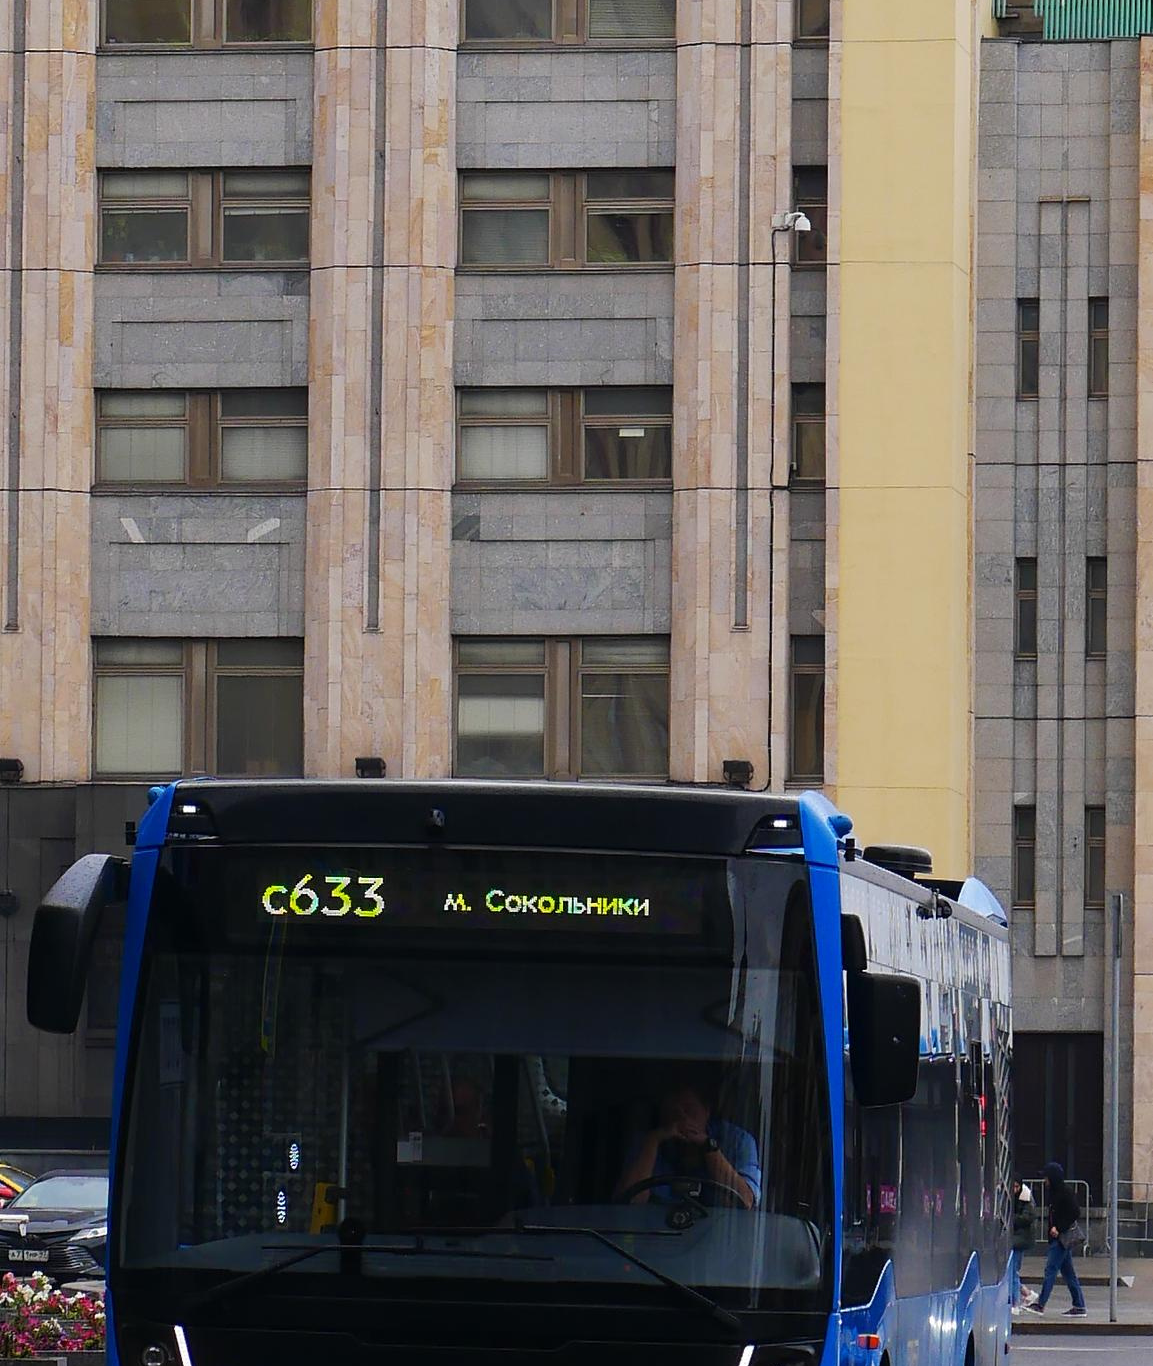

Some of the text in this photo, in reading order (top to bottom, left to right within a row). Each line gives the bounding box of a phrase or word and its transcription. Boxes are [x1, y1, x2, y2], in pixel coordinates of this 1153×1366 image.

[261, 873, 650, 917] с633 м. Сокольники
